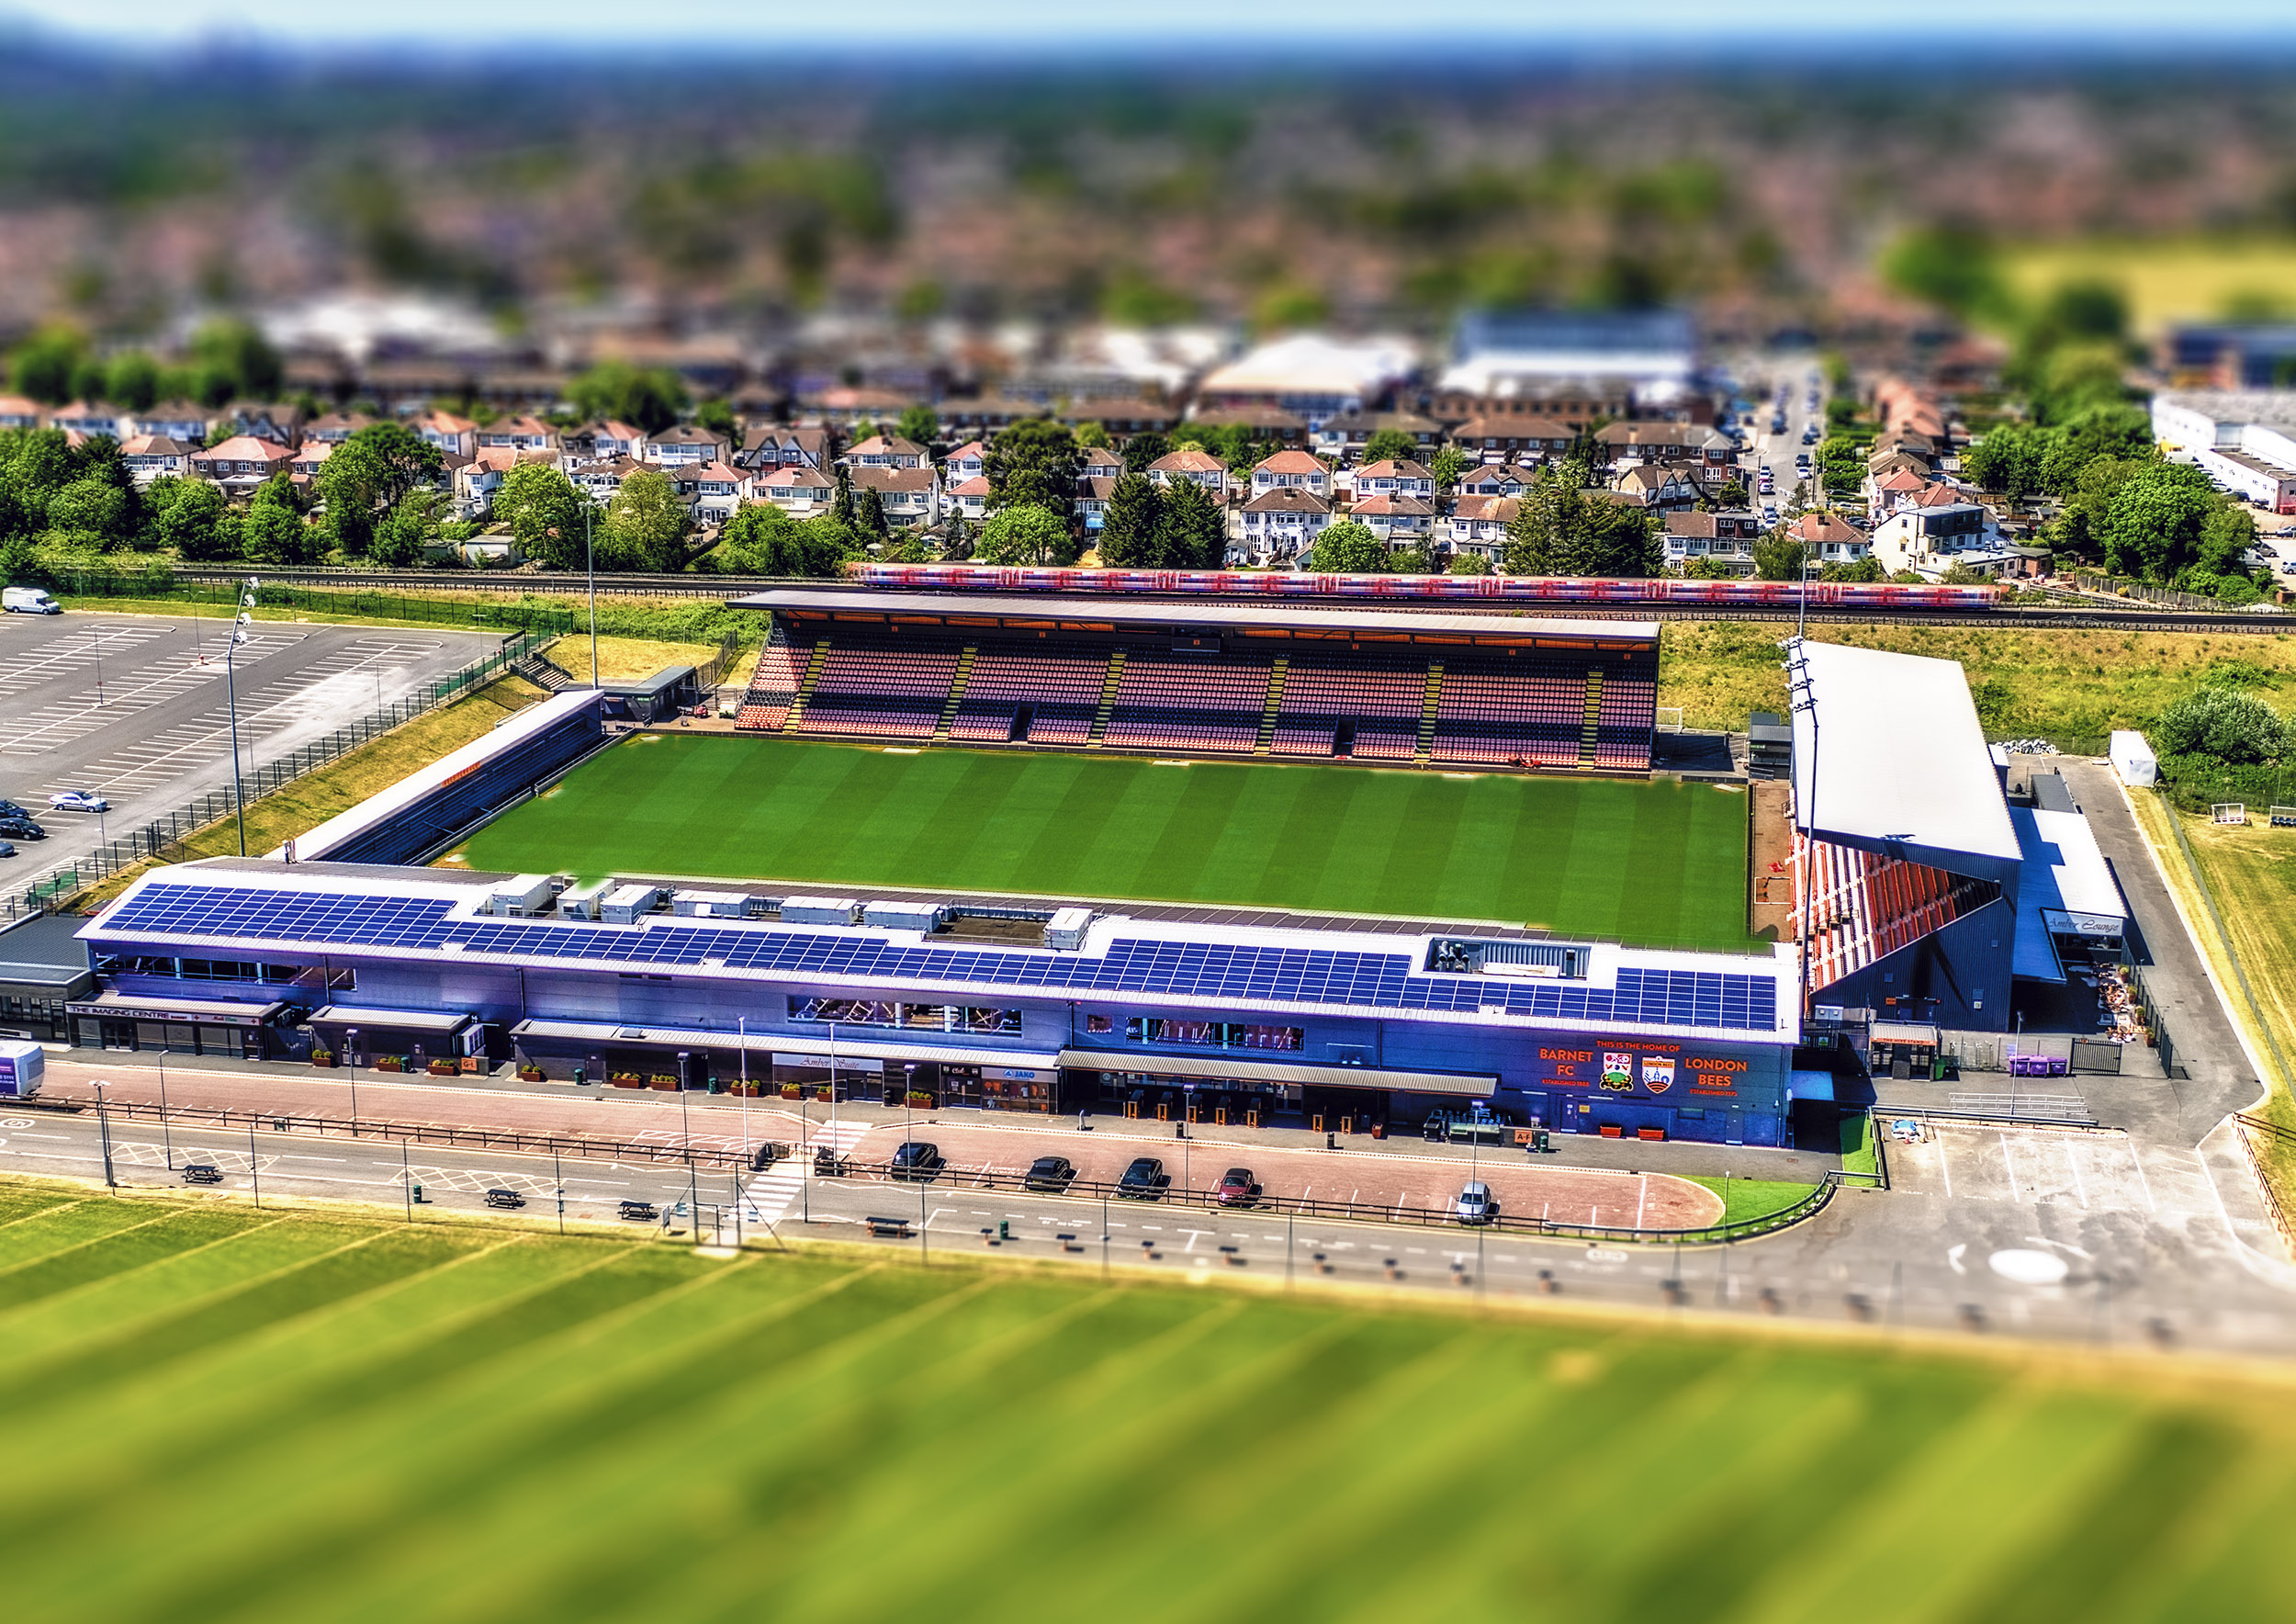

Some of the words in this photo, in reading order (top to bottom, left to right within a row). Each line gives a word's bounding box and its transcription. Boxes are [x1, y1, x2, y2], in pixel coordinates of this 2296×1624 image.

[2048, 918, 2079, 929] Amber
[2081, 919, 2119, 932] Lounge
[92, 1008, 130, 1017] IMAGING
[132, 1010, 170, 1019] CENTRE
[1596, 1040, 1615, 1049] THIS
[1625, 1042, 1640, 1050] THE
[1642, 1043, 1667, 1052] HOME
[1539, 1048, 1593, 1062] BARNET
[800, 1056, 830, 1067] Amber
[834, 1057, 860, 1068] Suite
[1684, 1057, 1748, 1072] LONDON
[1014, 1070, 1035, 1079] JAKO
[1557, 1065, 1575, 1076] FC
[1698, 1074, 1732, 1087] BEES
